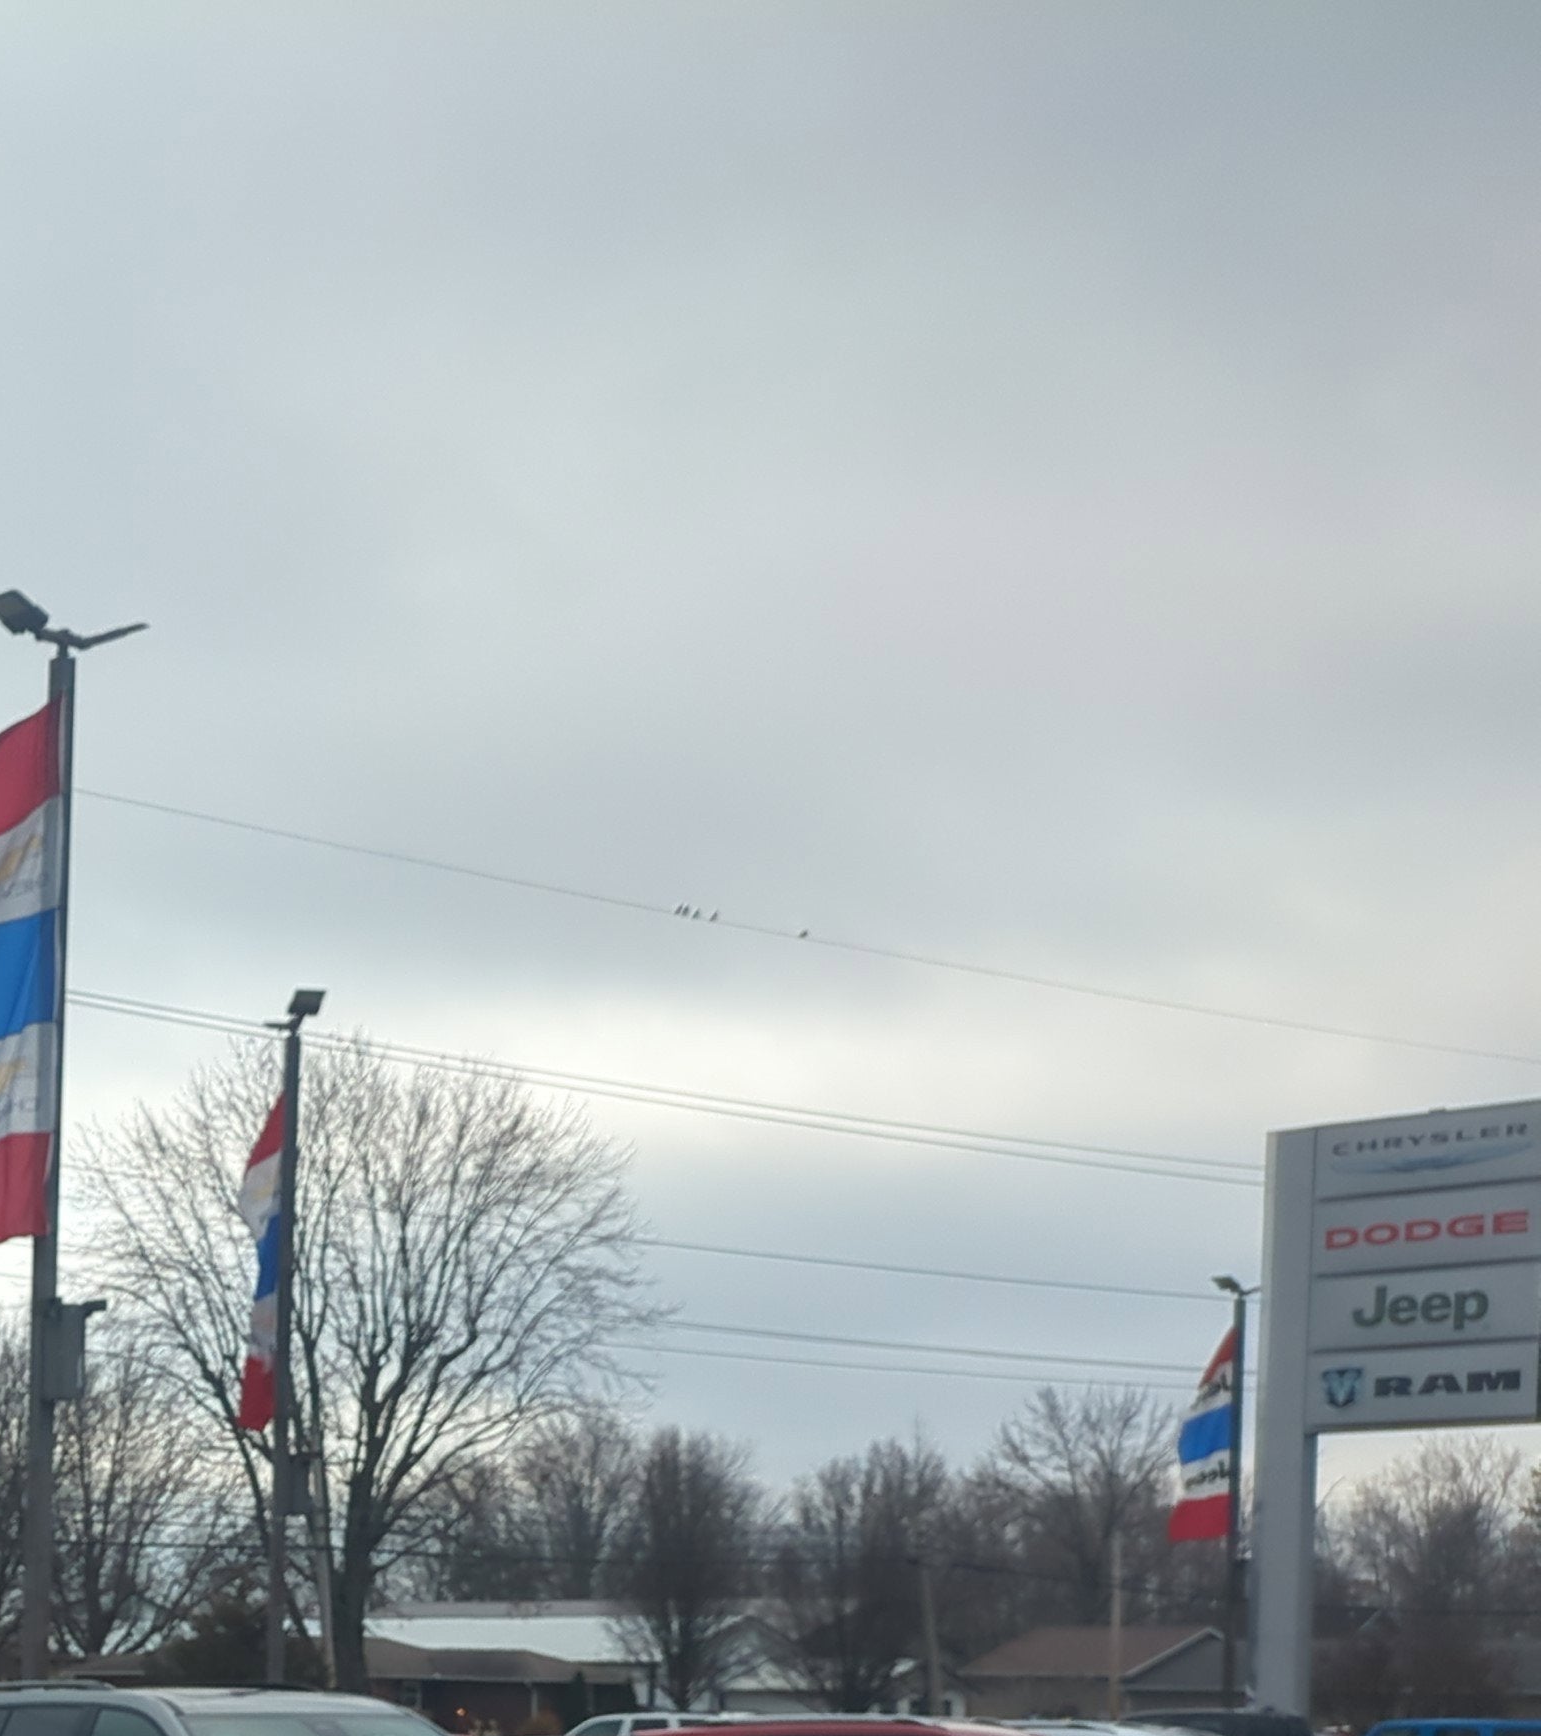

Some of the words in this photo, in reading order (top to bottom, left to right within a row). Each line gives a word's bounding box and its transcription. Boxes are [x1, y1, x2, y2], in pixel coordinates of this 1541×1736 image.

[1332, 1123, 1528, 1157] CHRYSLER
[1324, 1209, 1530, 1251] DODGE
[1351, 1285, 1490, 1331] Jeep
[1373, 1369, 1522, 1398] RAM
